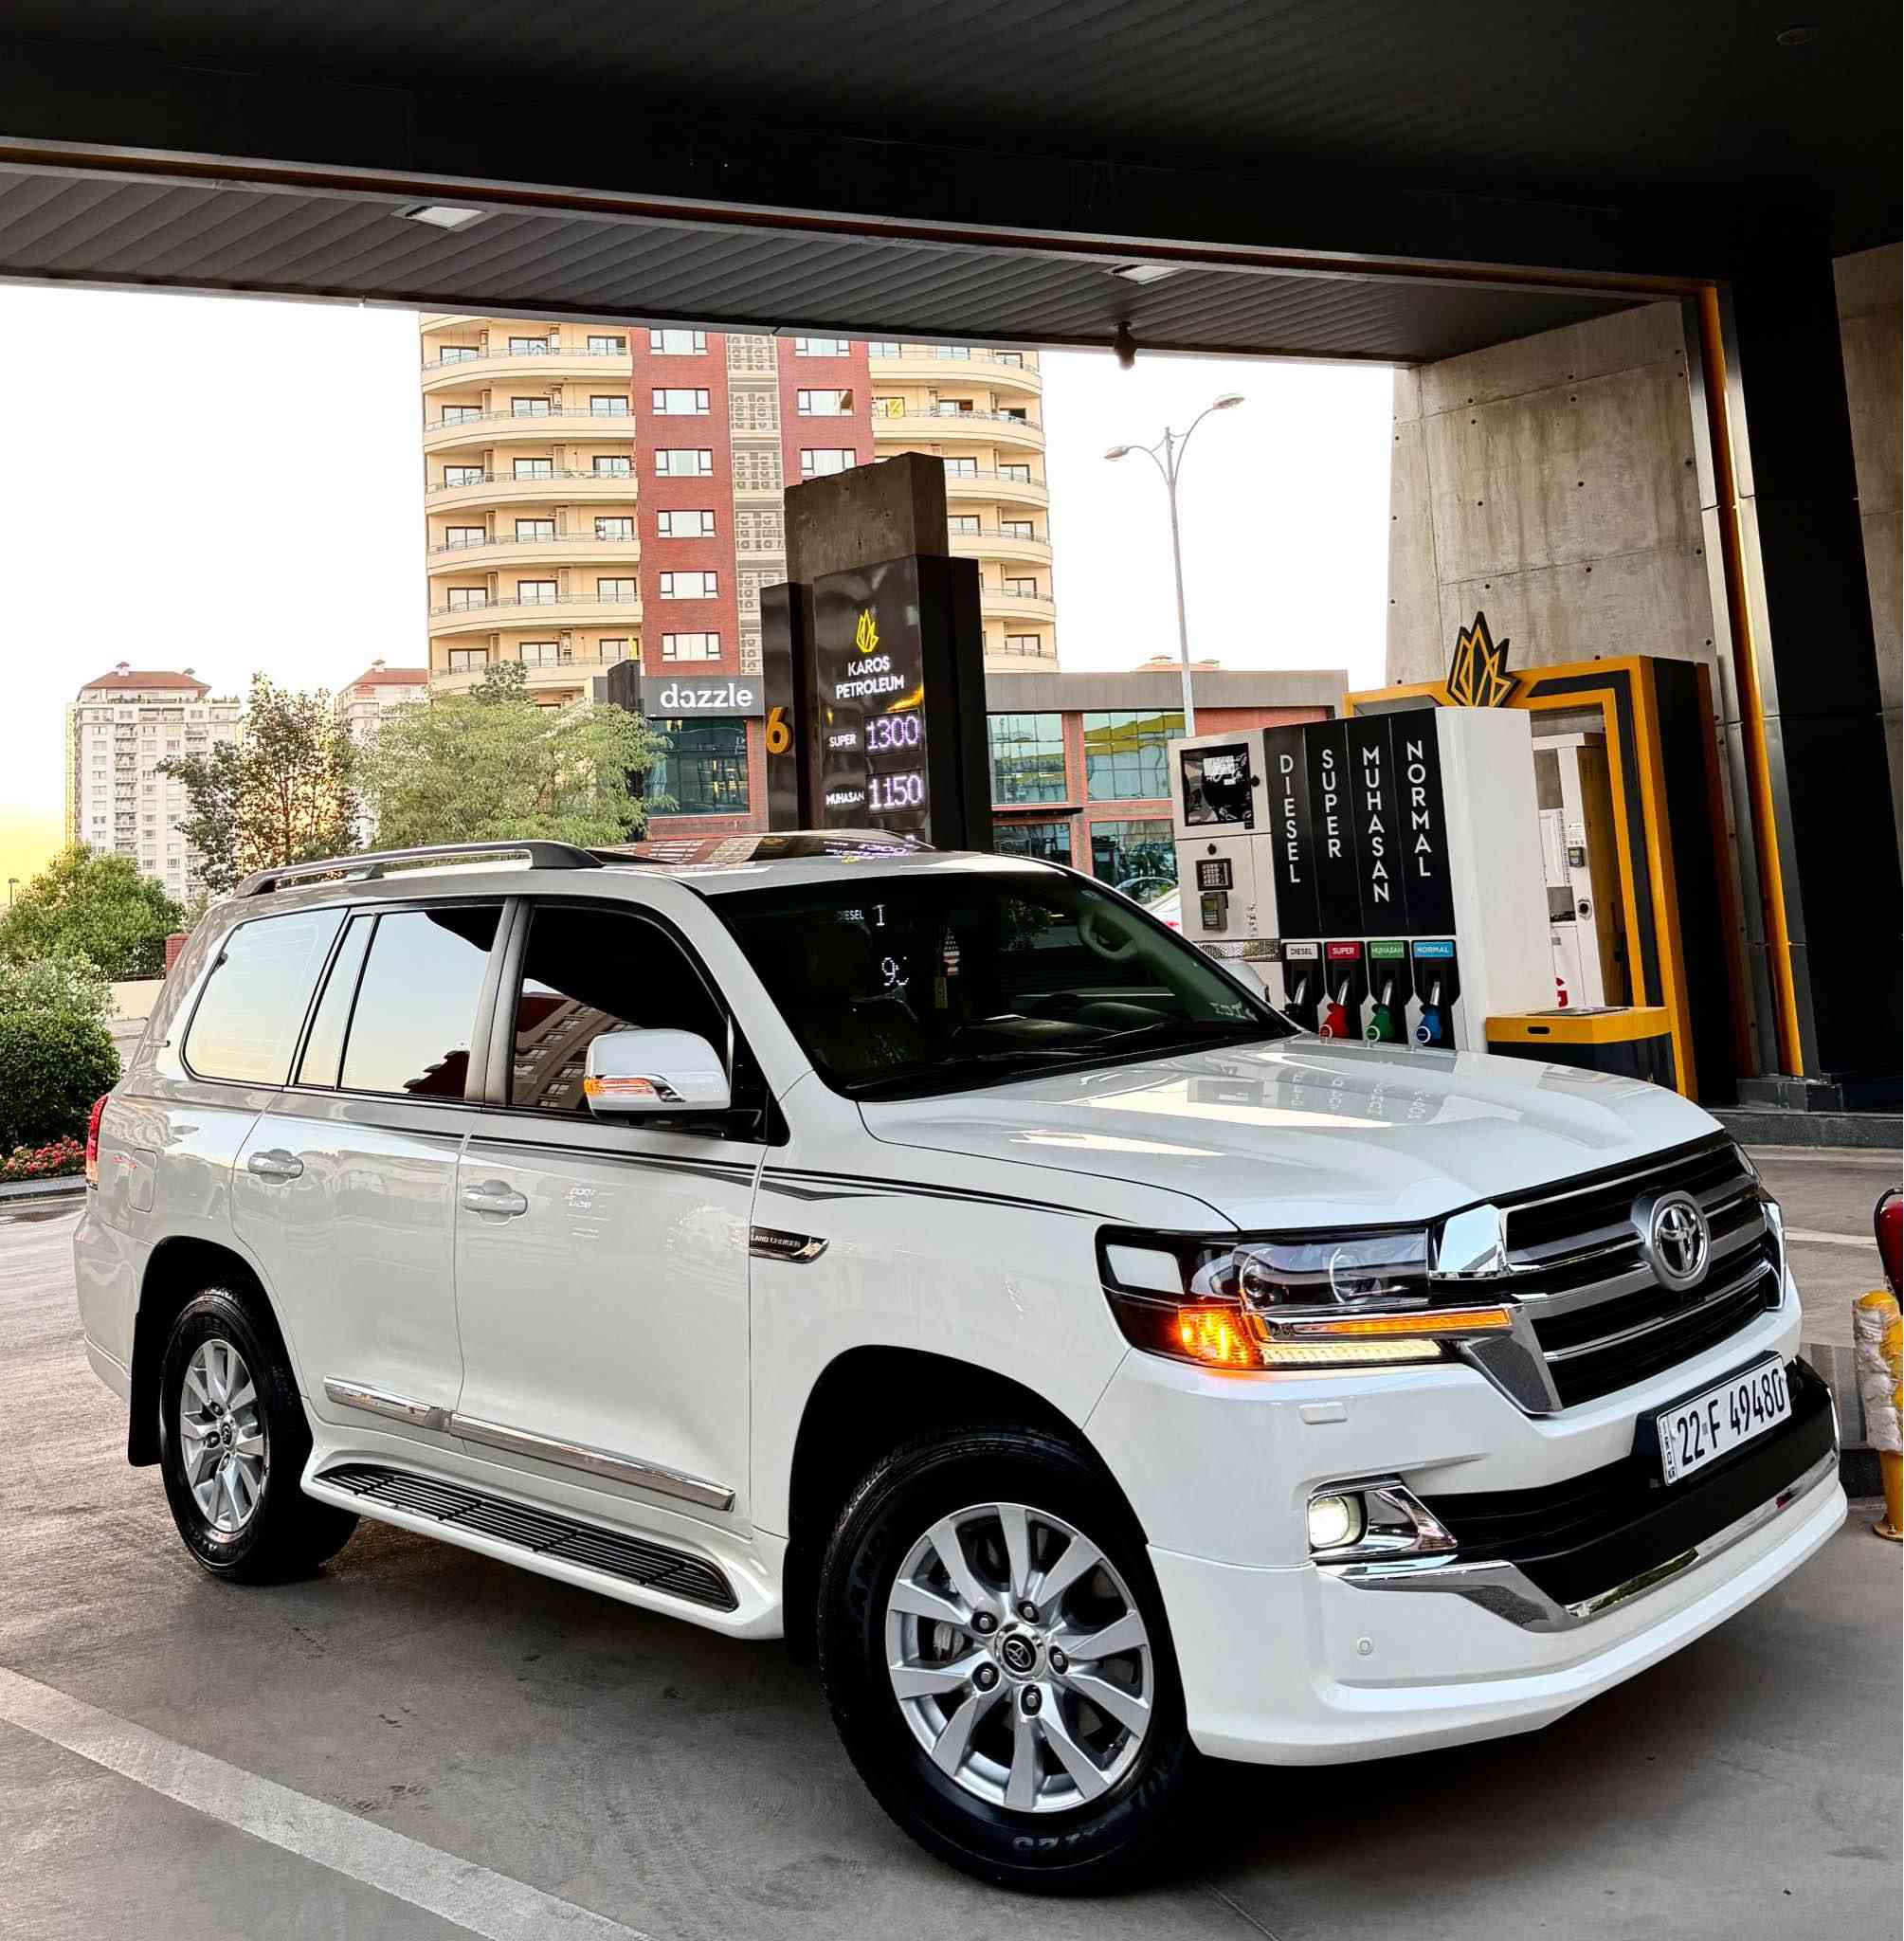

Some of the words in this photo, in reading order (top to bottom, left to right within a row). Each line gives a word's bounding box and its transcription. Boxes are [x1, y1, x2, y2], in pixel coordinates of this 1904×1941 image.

[847, 655, 891, 677] KAROS
[660, 682, 753, 709] dazzle
[835, 674, 905, 699] PETROLEUM
[765, 705, 793, 754] 6
[828, 733, 857, 748] SUPER
[866, 716, 920, 751] 1300
[825, 790, 865, 806] MUHASAN
[868, 773, 923, 810] 1150
[1321, 749, 1342, 859] SUPER
[1406, 740, 1432, 878] NORMAL
[1279, 753, 1301, 884] DIESEL
[1362, 746, 1390, 903] MUHASAN
[836, 909, 864, 921] DIESEL
[1290, 947, 1313, 955] DIESEL
[1332, 947, 1354, 955] SUPER
[1677, 1410, 1705, 1466] 22
[1708, 1398, 1721, 1449] F
[1729, 1368, 1786, 1436] 49480
